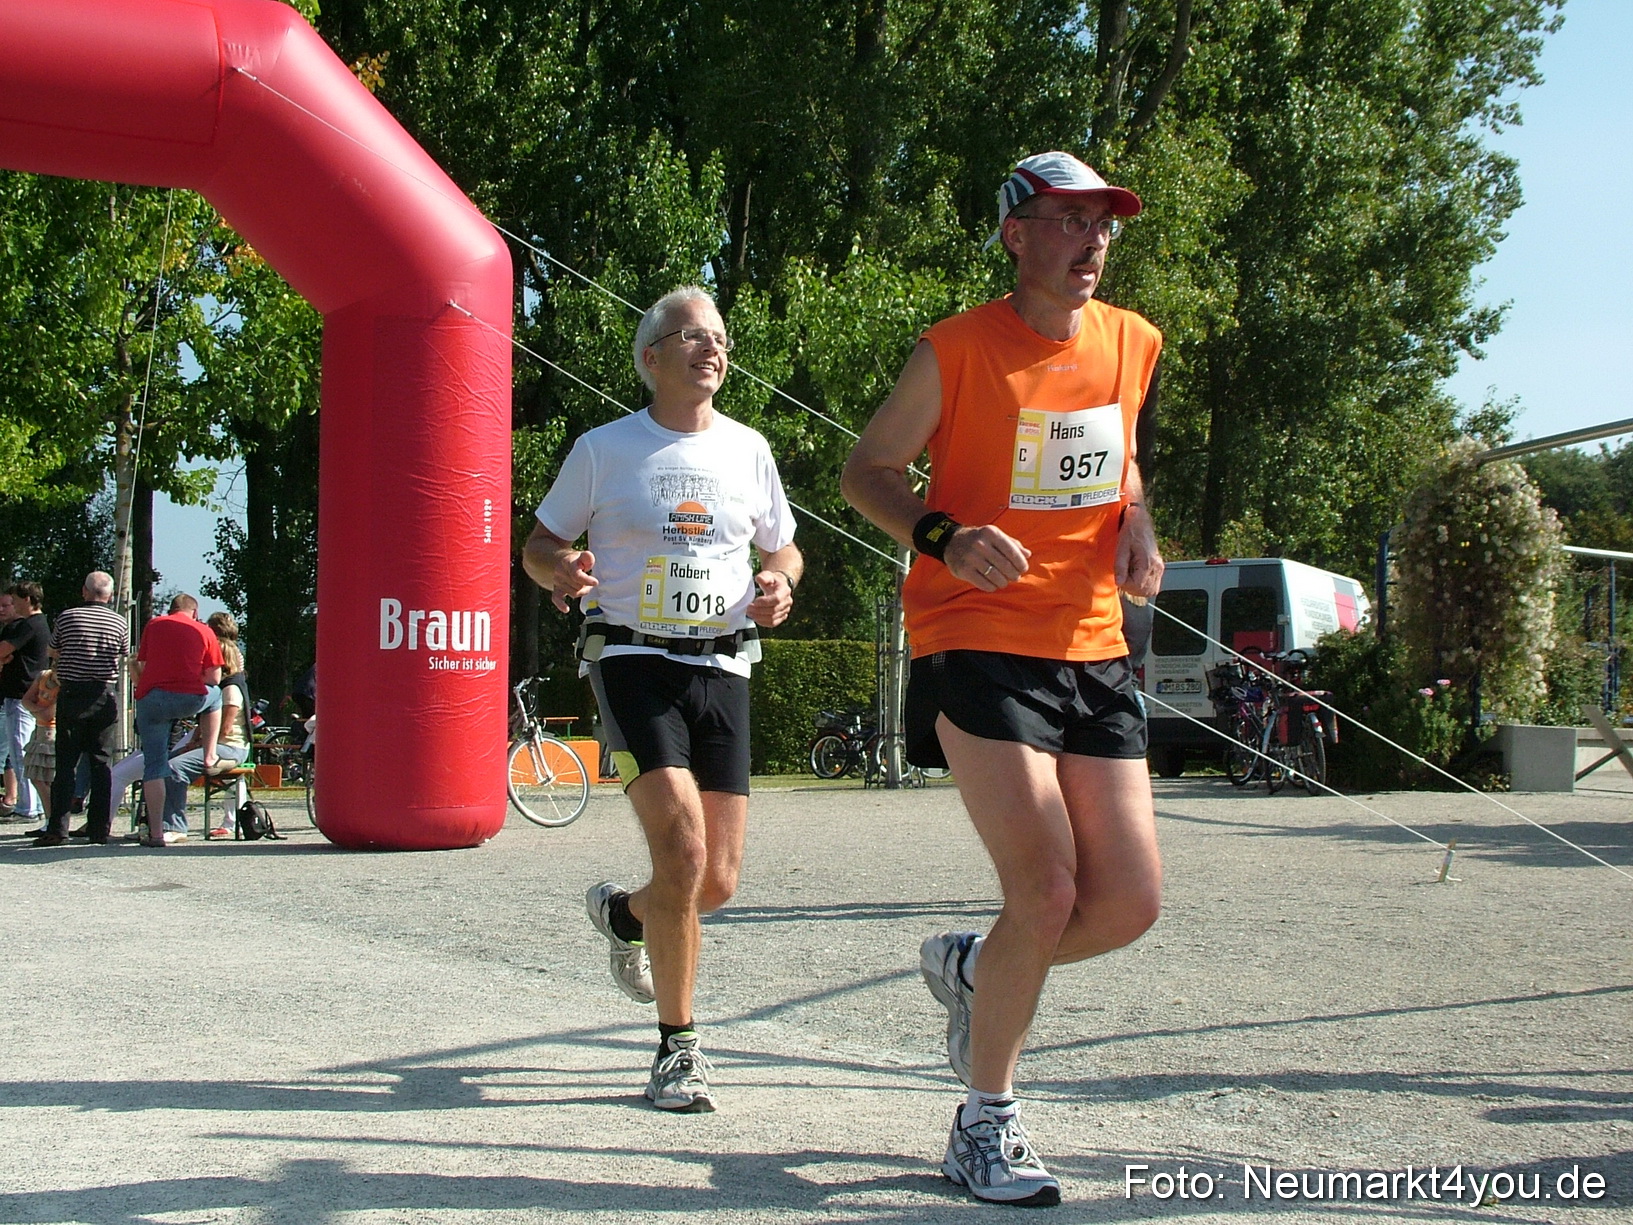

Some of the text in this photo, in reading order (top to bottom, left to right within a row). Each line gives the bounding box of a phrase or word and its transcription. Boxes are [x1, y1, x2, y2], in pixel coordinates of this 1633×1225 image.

[1050, 421, 1085, 440] Hans
[1019, 448, 1027, 462] C
[1059, 450, 1109, 481] 957
[662, 525, 716, 537] Herbstlauf
[670, 562, 710, 580] Robert
[646, 583, 653, 596] B
[671, 591, 726, 617] 1018
[379, 597, 491, 652] Braun
[428, 655, 497, 670] Sicher ist sicher
